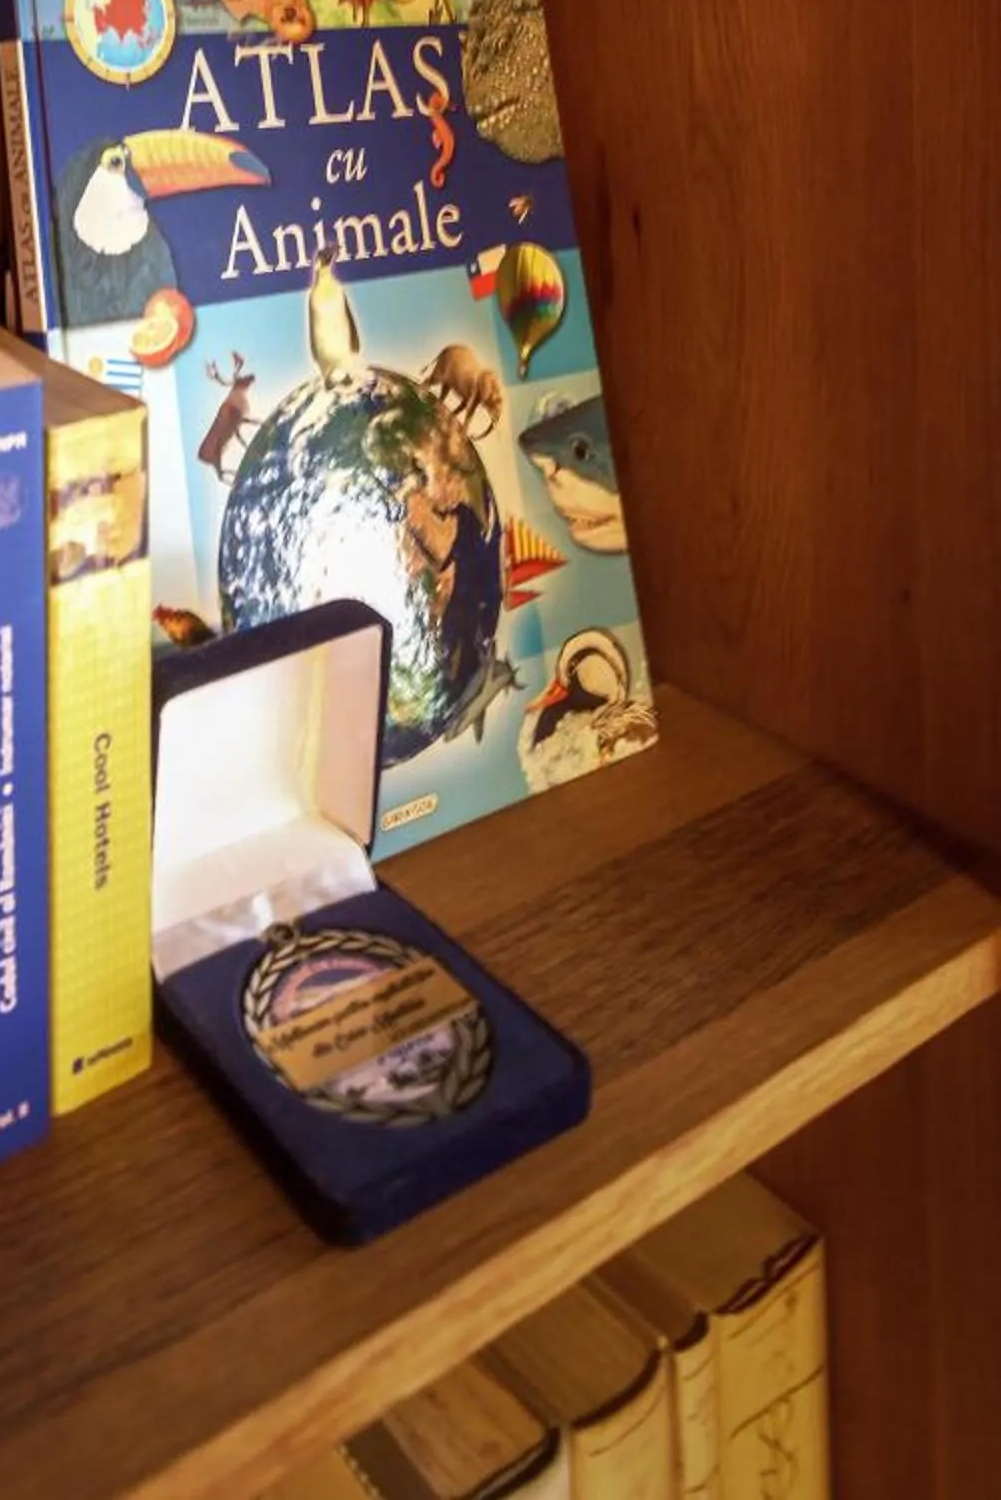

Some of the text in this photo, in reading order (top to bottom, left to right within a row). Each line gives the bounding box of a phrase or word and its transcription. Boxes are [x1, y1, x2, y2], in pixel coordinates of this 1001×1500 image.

[5, 65, 29, 190] ANIMALE
[180, 36, 450, 132] ATLAS
[325, 147, 368, 184] cu
[19, 220, 39, 303] ATLAS
[220, 180, 462, 279] Animale
[94, 732, 112, 891] Cool Hotels
